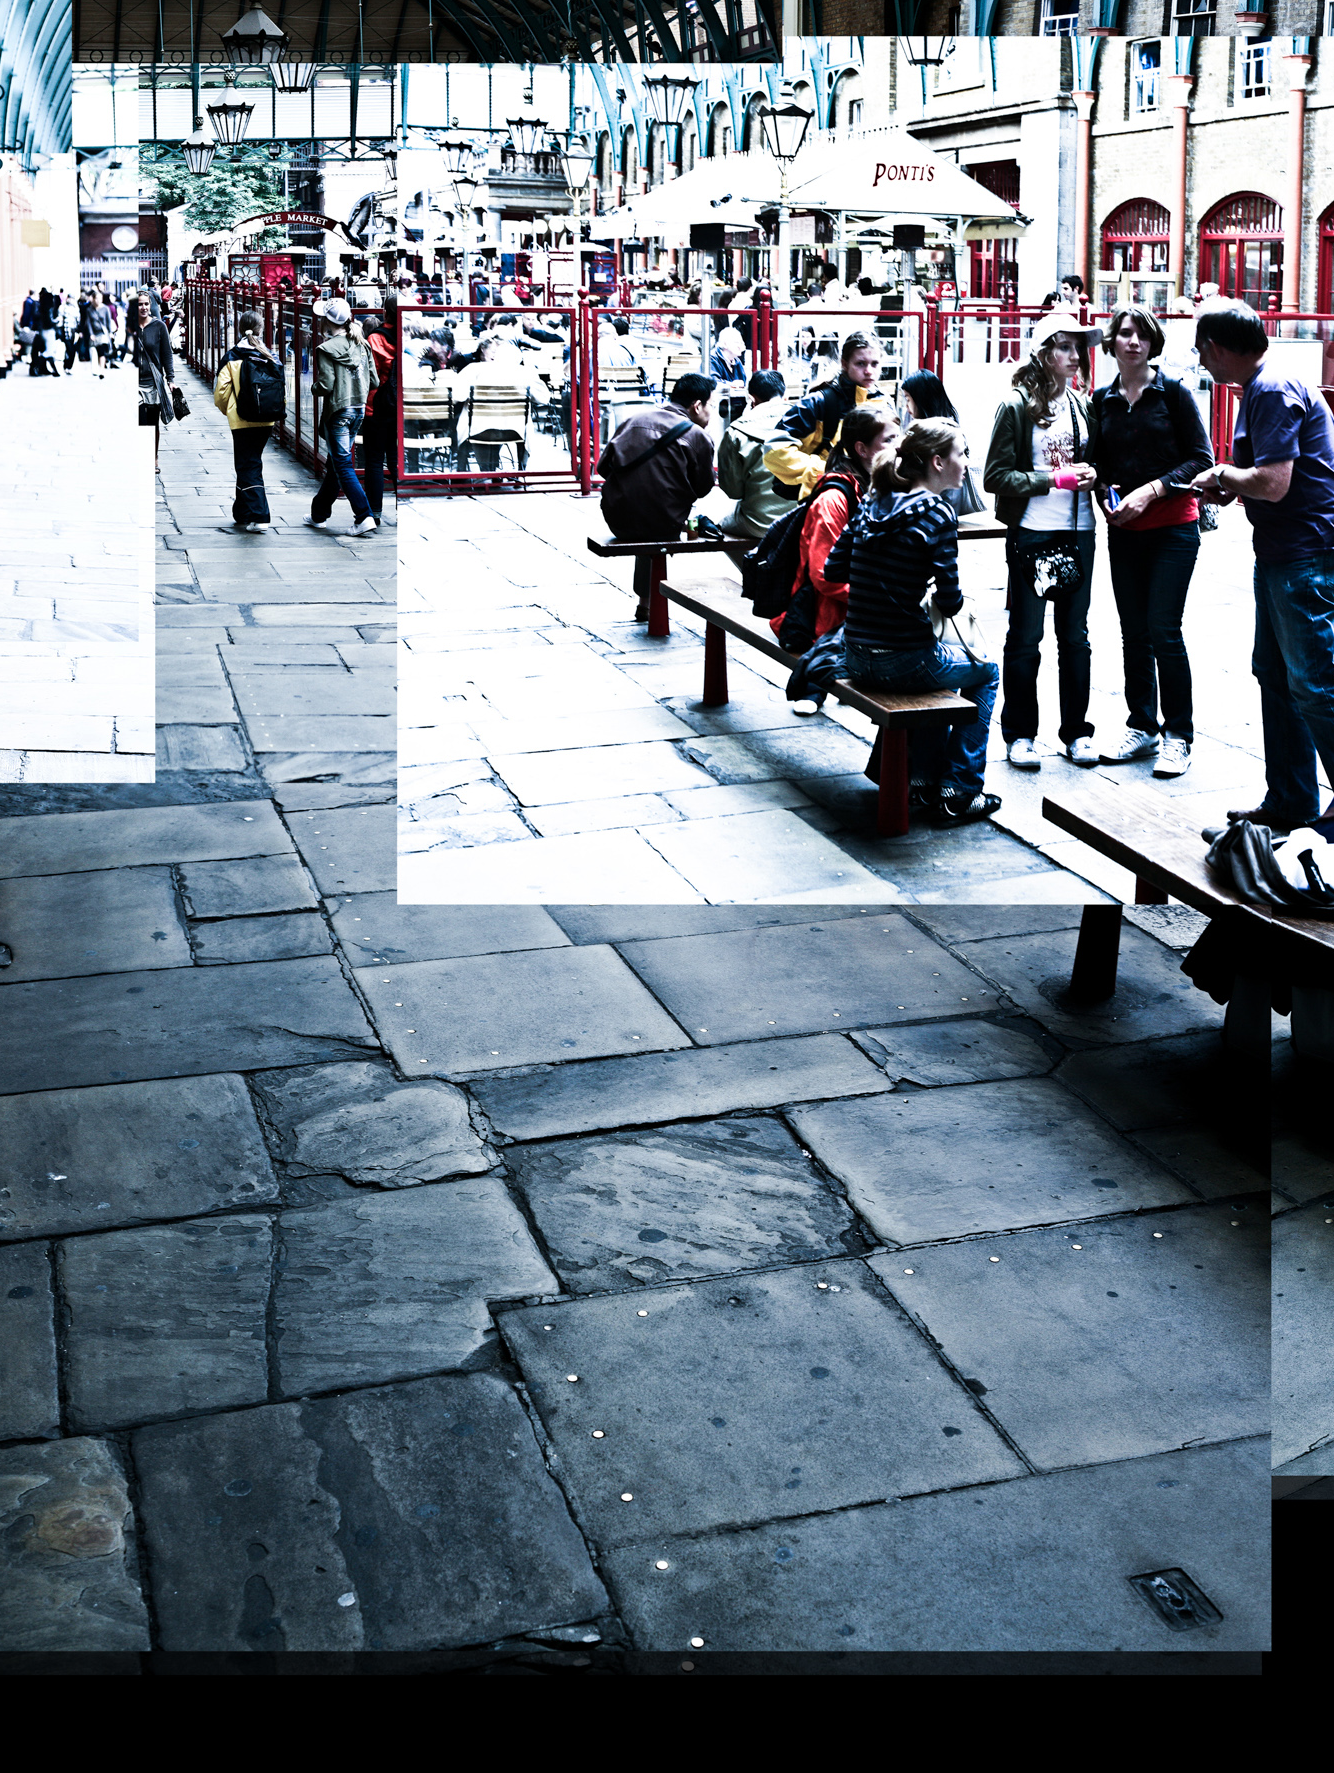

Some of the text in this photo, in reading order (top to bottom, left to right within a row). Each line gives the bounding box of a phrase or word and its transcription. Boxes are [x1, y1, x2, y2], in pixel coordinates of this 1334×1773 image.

[872, 162, 935, 187] PONTI'S
[261, 213, 329, 226] PPLE MARKET
